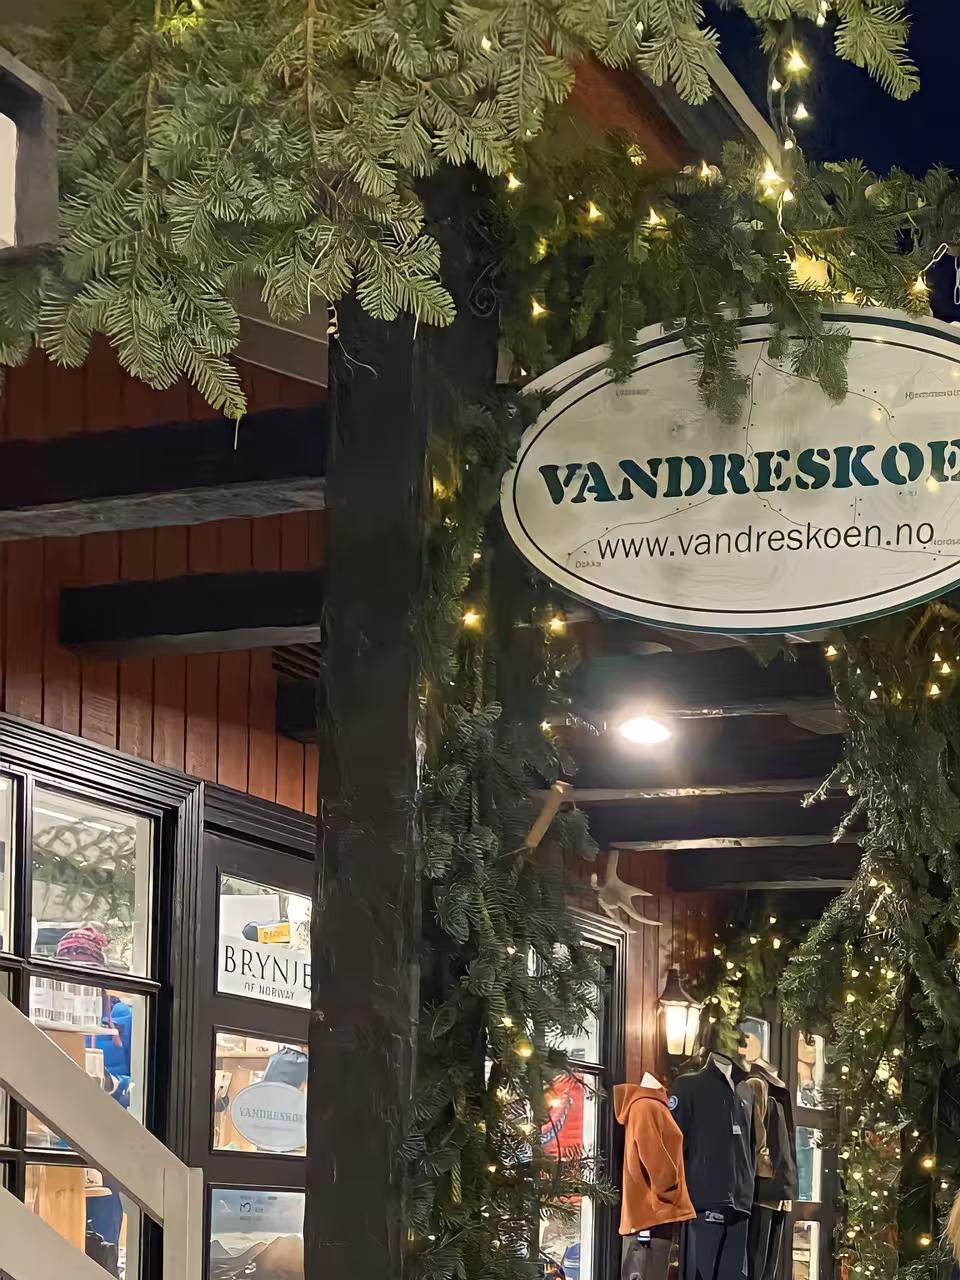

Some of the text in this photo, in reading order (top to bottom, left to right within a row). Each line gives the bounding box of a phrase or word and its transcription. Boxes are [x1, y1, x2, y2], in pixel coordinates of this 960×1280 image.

[597, 521, 935, 561] www.vandreskoen.no
[223, 944, 312, 991] BRYNJE
[244, 981, 296, 1001] OF NORWAY
